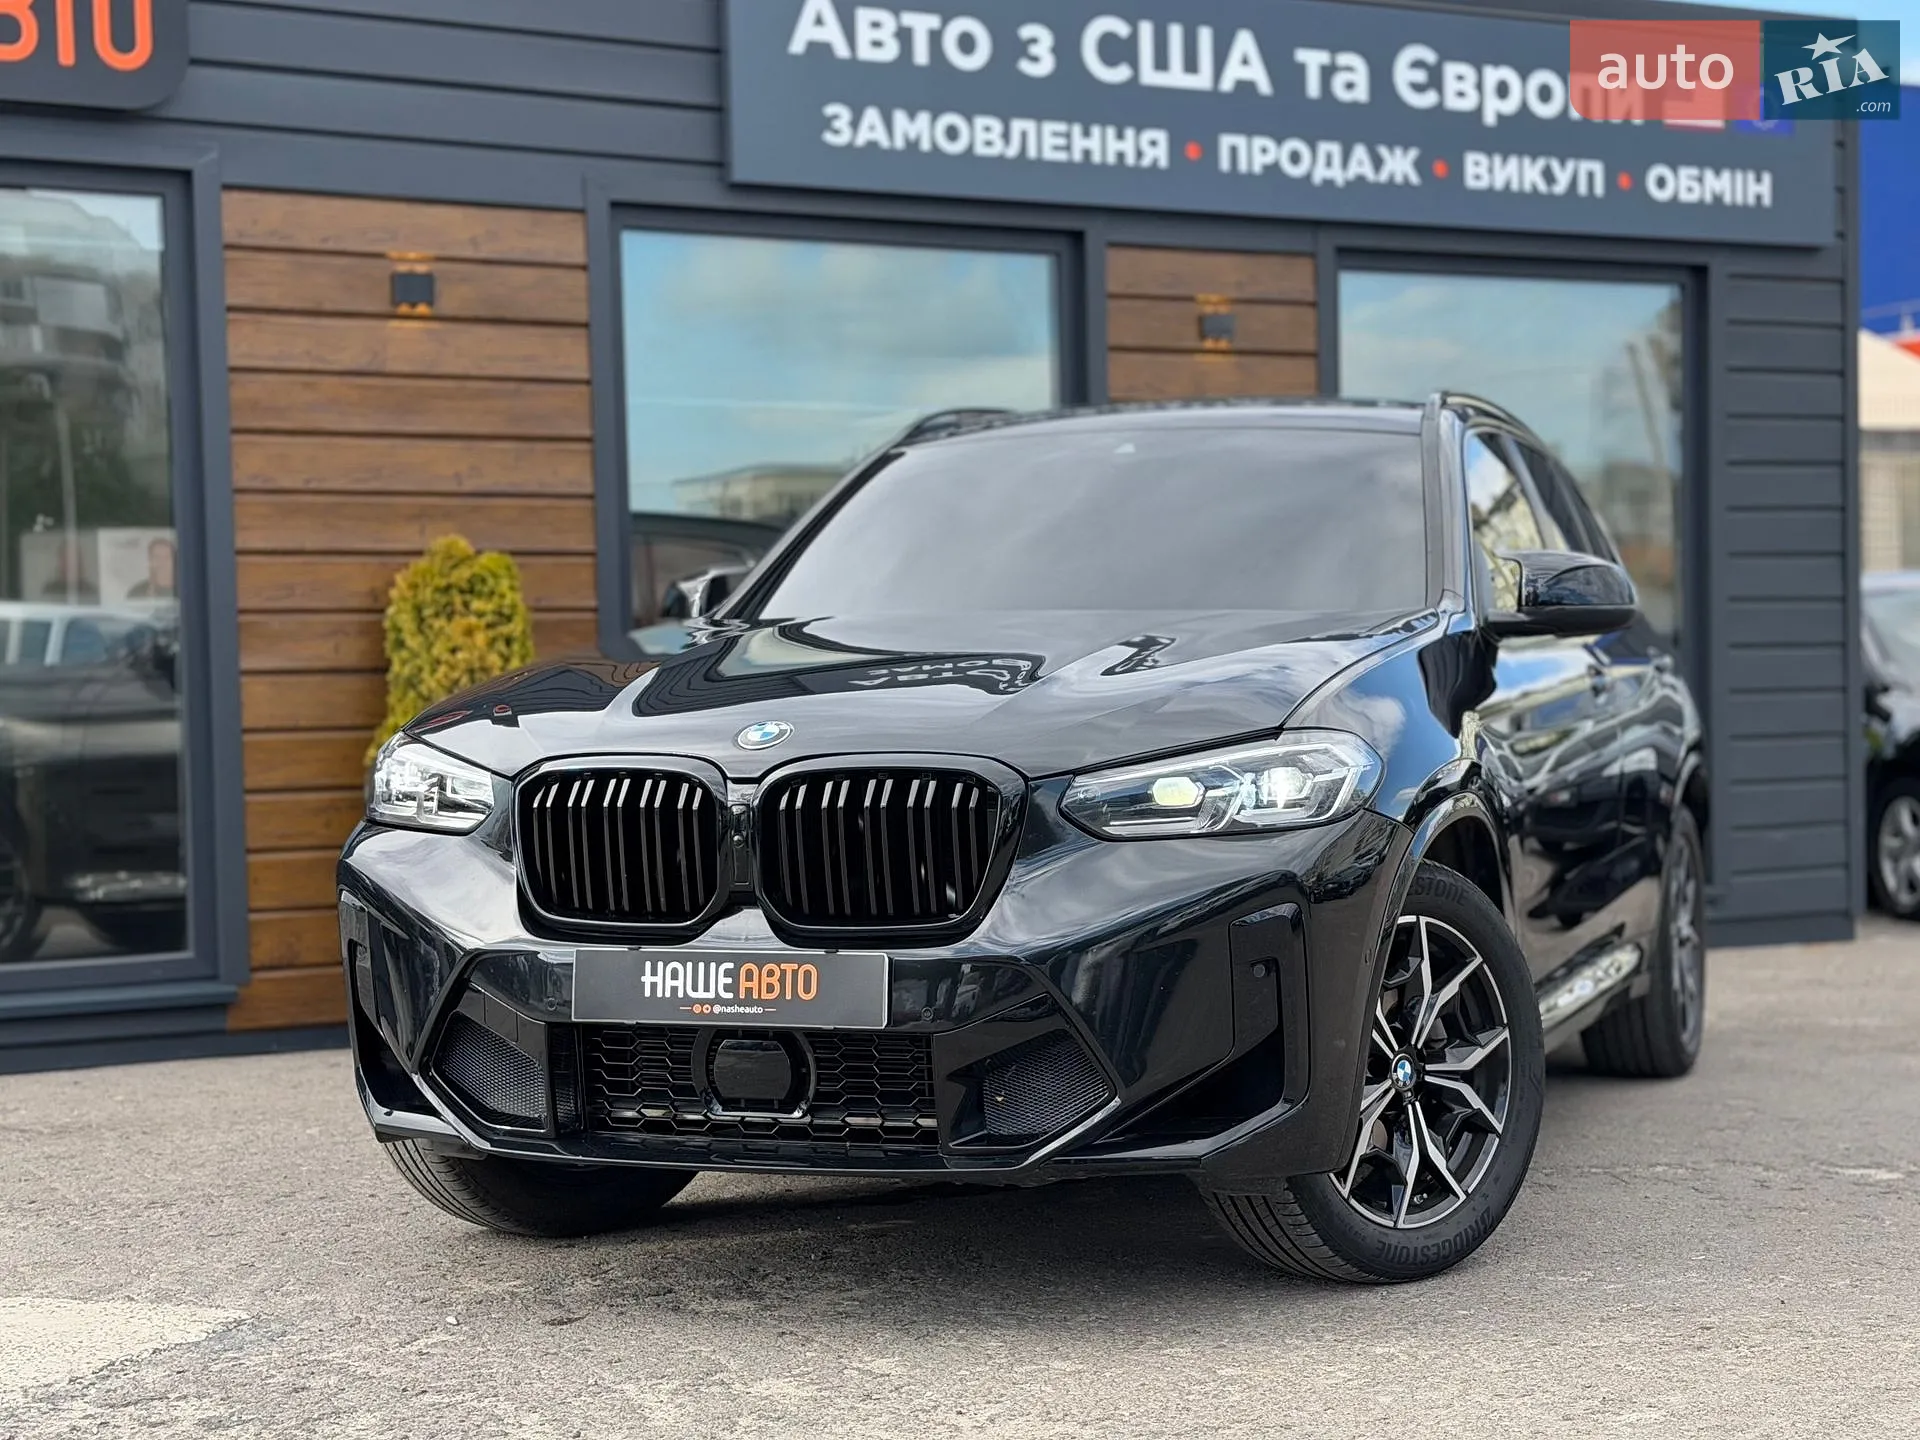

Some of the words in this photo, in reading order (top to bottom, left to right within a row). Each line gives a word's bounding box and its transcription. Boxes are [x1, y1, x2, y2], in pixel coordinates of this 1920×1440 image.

[1080, 15, 1274, 97] США
[1294, 46, 1371, 105] та
[821, 103, 1170, 170] ЗАМОВЛЕННЯ
[1218, 133, 1422, 186] ПРОДАЖ
[1462, 150, 1606, 198] ВИКУП
[1645, 164, 1773, 208] ОБМІН
[641, 960, 735, 999] НАШЕ
[738, 961, 819, 1001] АВТО
[713, 1004, 764, 1015] @nasheauto
